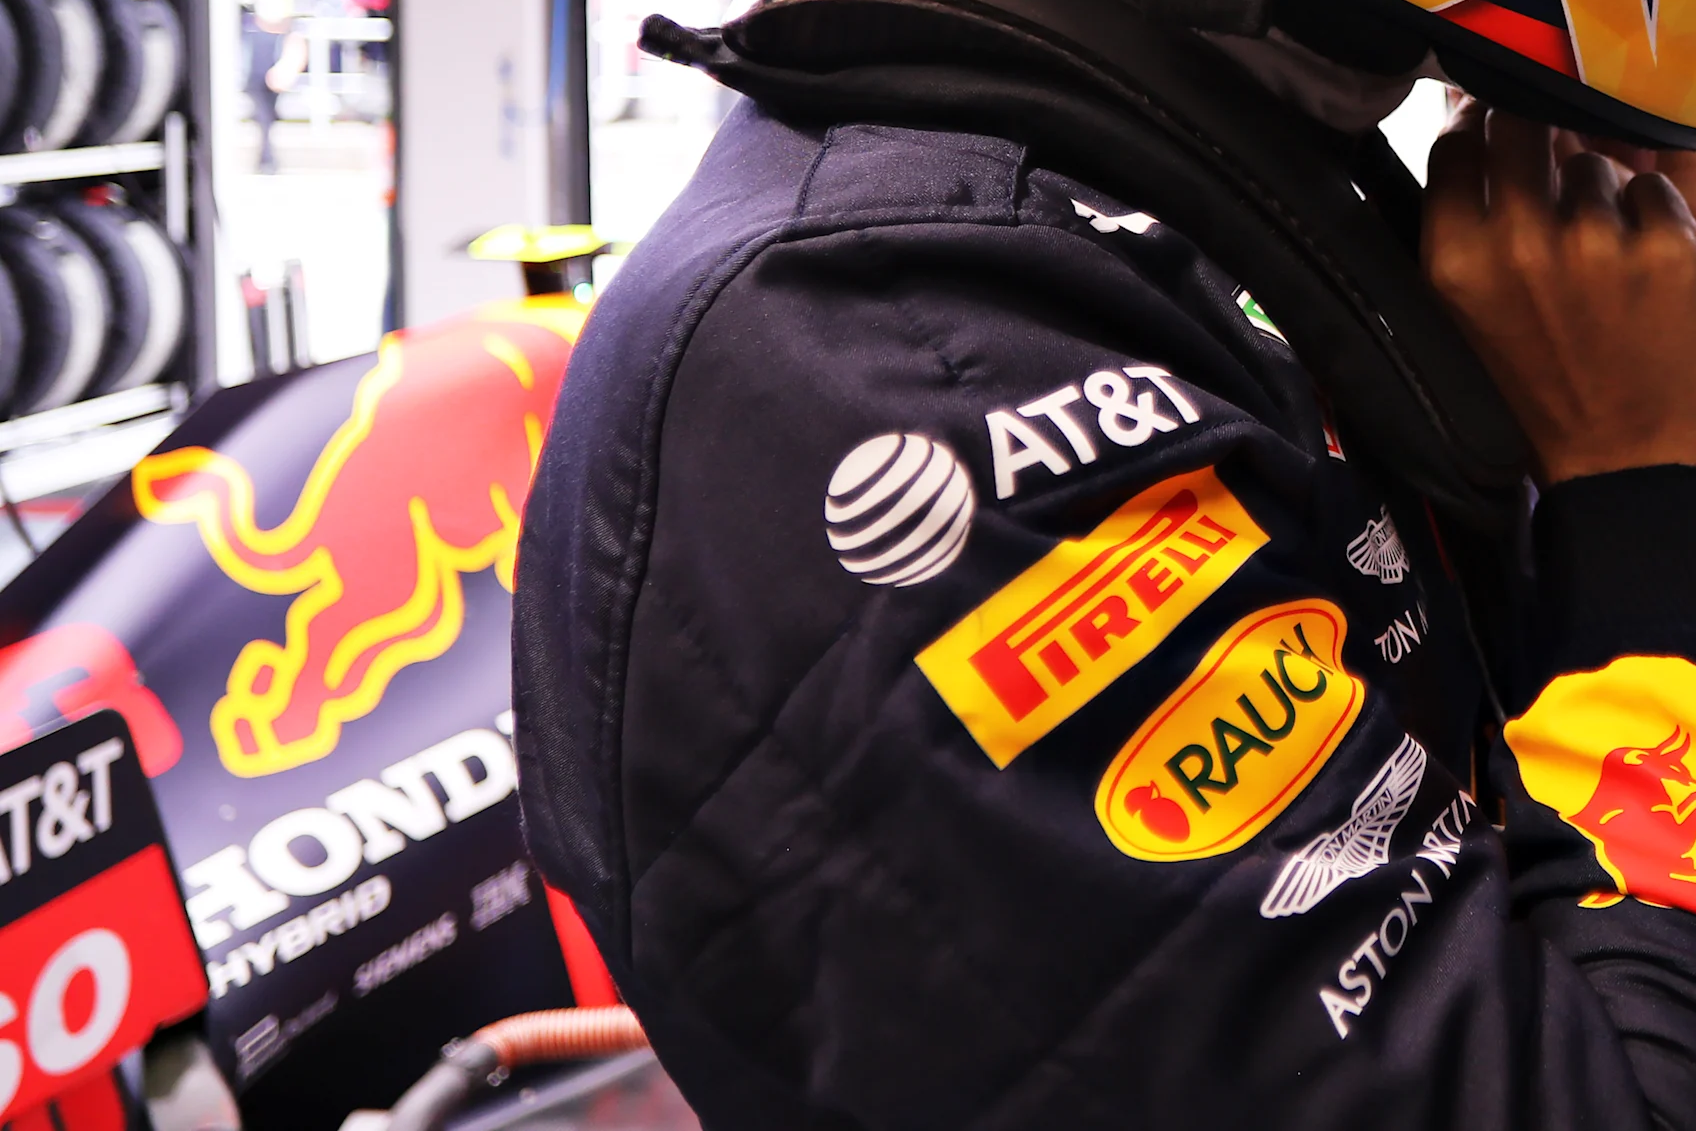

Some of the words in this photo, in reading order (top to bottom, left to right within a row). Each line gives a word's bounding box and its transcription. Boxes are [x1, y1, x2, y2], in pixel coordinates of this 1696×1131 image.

[985, 366, 1202, 500] AT&T
[968, 488, 1237, 723] PIRELLI
[1164, 622, 1334, 815] RAUCH
[0, 737, 124, 886] T&T
[184, 709, 519, 950] HOND
[206, 873, 392, 999] HYBRID
[1320, 869, 1433, 1040] ASTON
